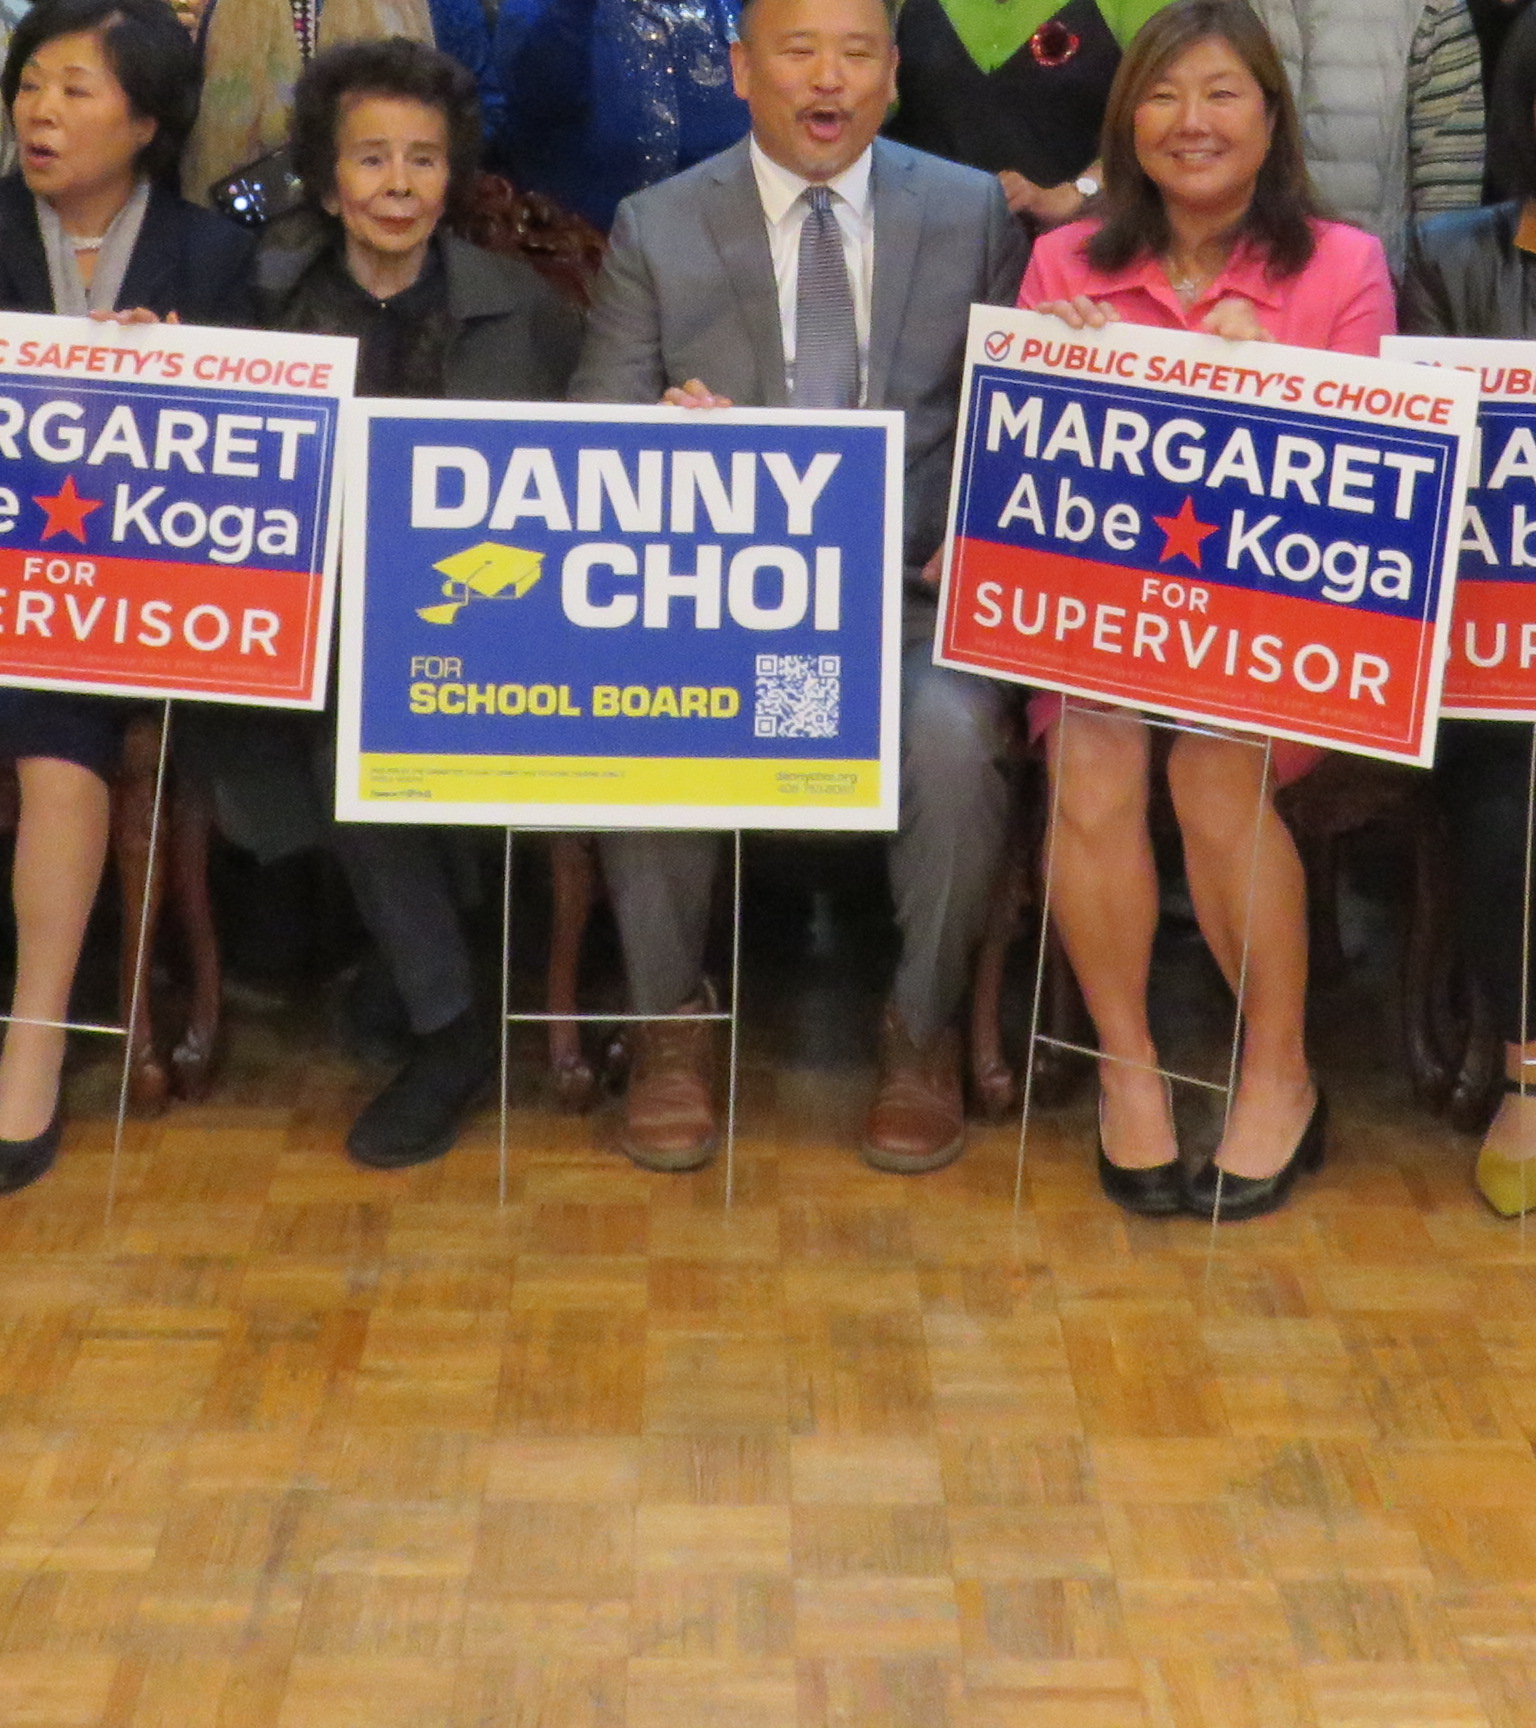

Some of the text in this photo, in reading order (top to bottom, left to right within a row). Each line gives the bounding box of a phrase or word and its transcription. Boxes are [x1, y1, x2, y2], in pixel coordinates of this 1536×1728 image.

[18, 342, 183, 377] SAFETY'S
[195, 356, 332, 388] CHOICE
[1021, 339, 1454, 425] PUBLIC SAFETY'S CHOICE
[412, 446, 841, 534] DANNY
[987, 392, 1434, 519] MARGARET
[113, 484, 298, 563] Koga
[998, 474, 1411, 602] Abe Koga
[24, 558, 95, 586] FOR
[562, 543, 840, 630] CHOI
[1142, 579, 1208, 613] FOR
[412, 656, 461, 678] FOR
[974, 579, 1389, 704] SUPERVISOR
[409, 683, 741, 718] SCHOOL BOARD
